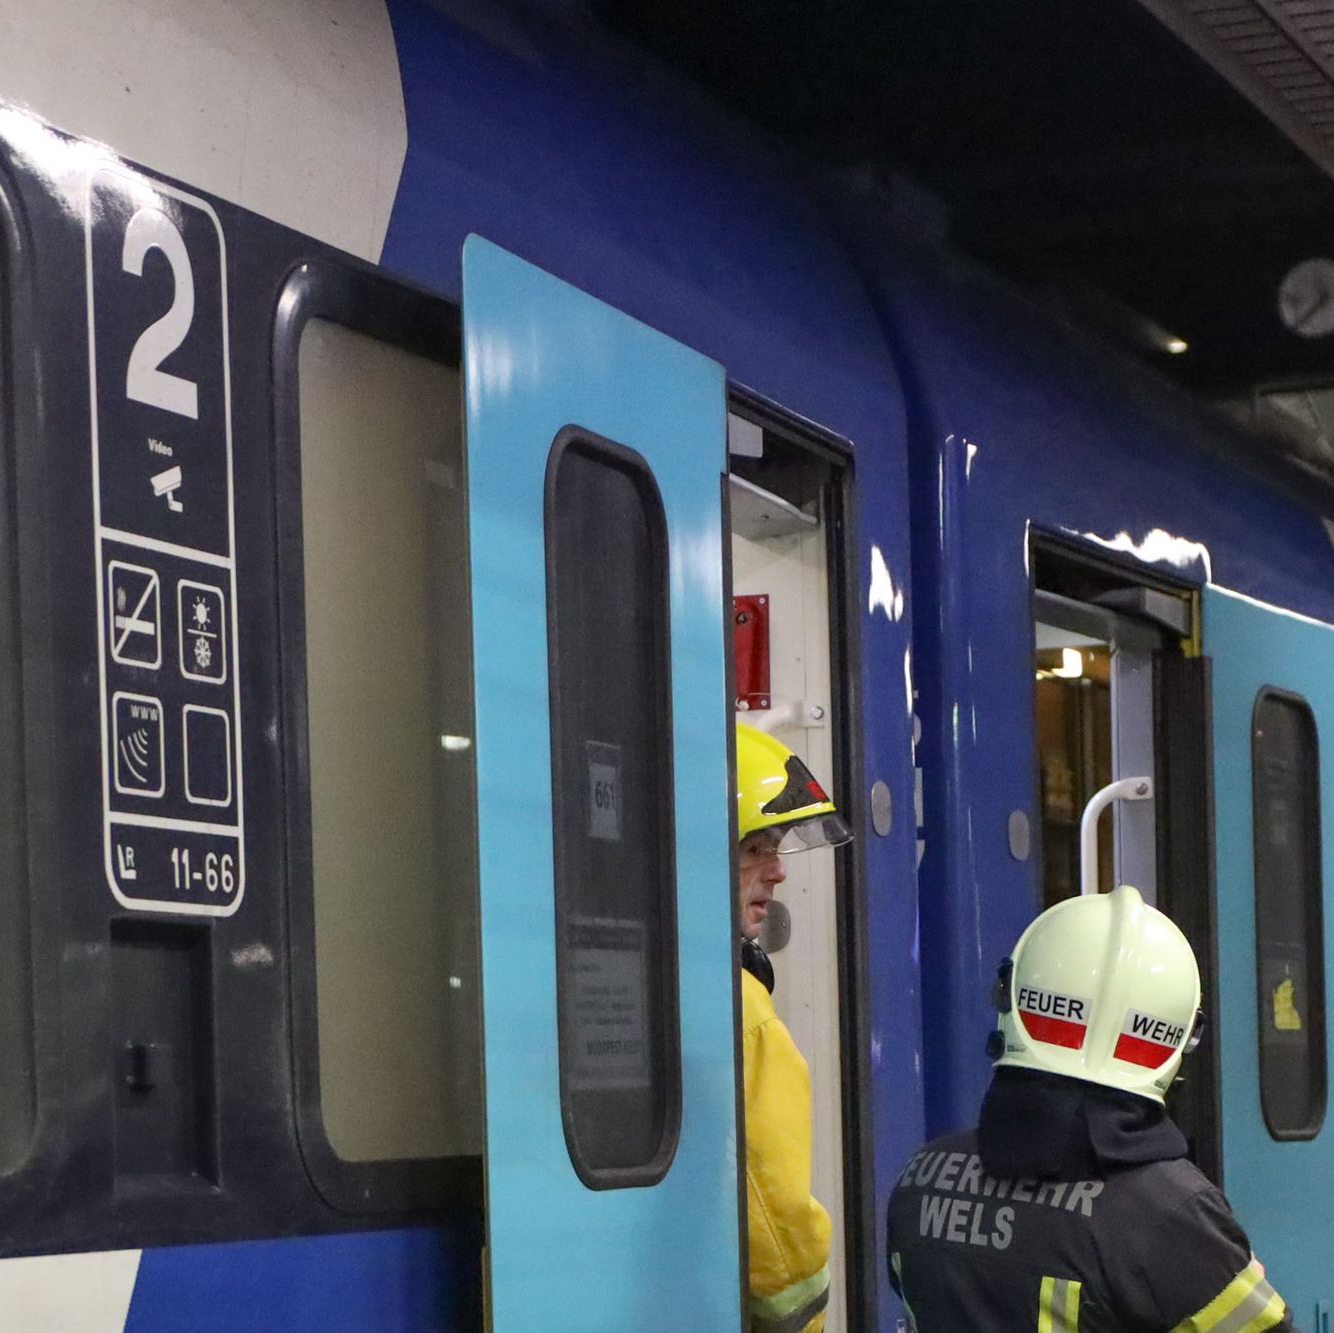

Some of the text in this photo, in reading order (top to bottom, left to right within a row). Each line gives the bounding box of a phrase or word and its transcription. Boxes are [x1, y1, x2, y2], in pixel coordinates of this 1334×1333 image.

[121, 207, 199, 420] 2
[148, 437, 173, 456] Video
[171, 847, 234, 893] 11-66
[1018, 987, 1185, 1046] FEUER WEHR
[899, 1150, 1104, 1217] EUERWEHR
[919, 1195, 1015, 1250] WELS
